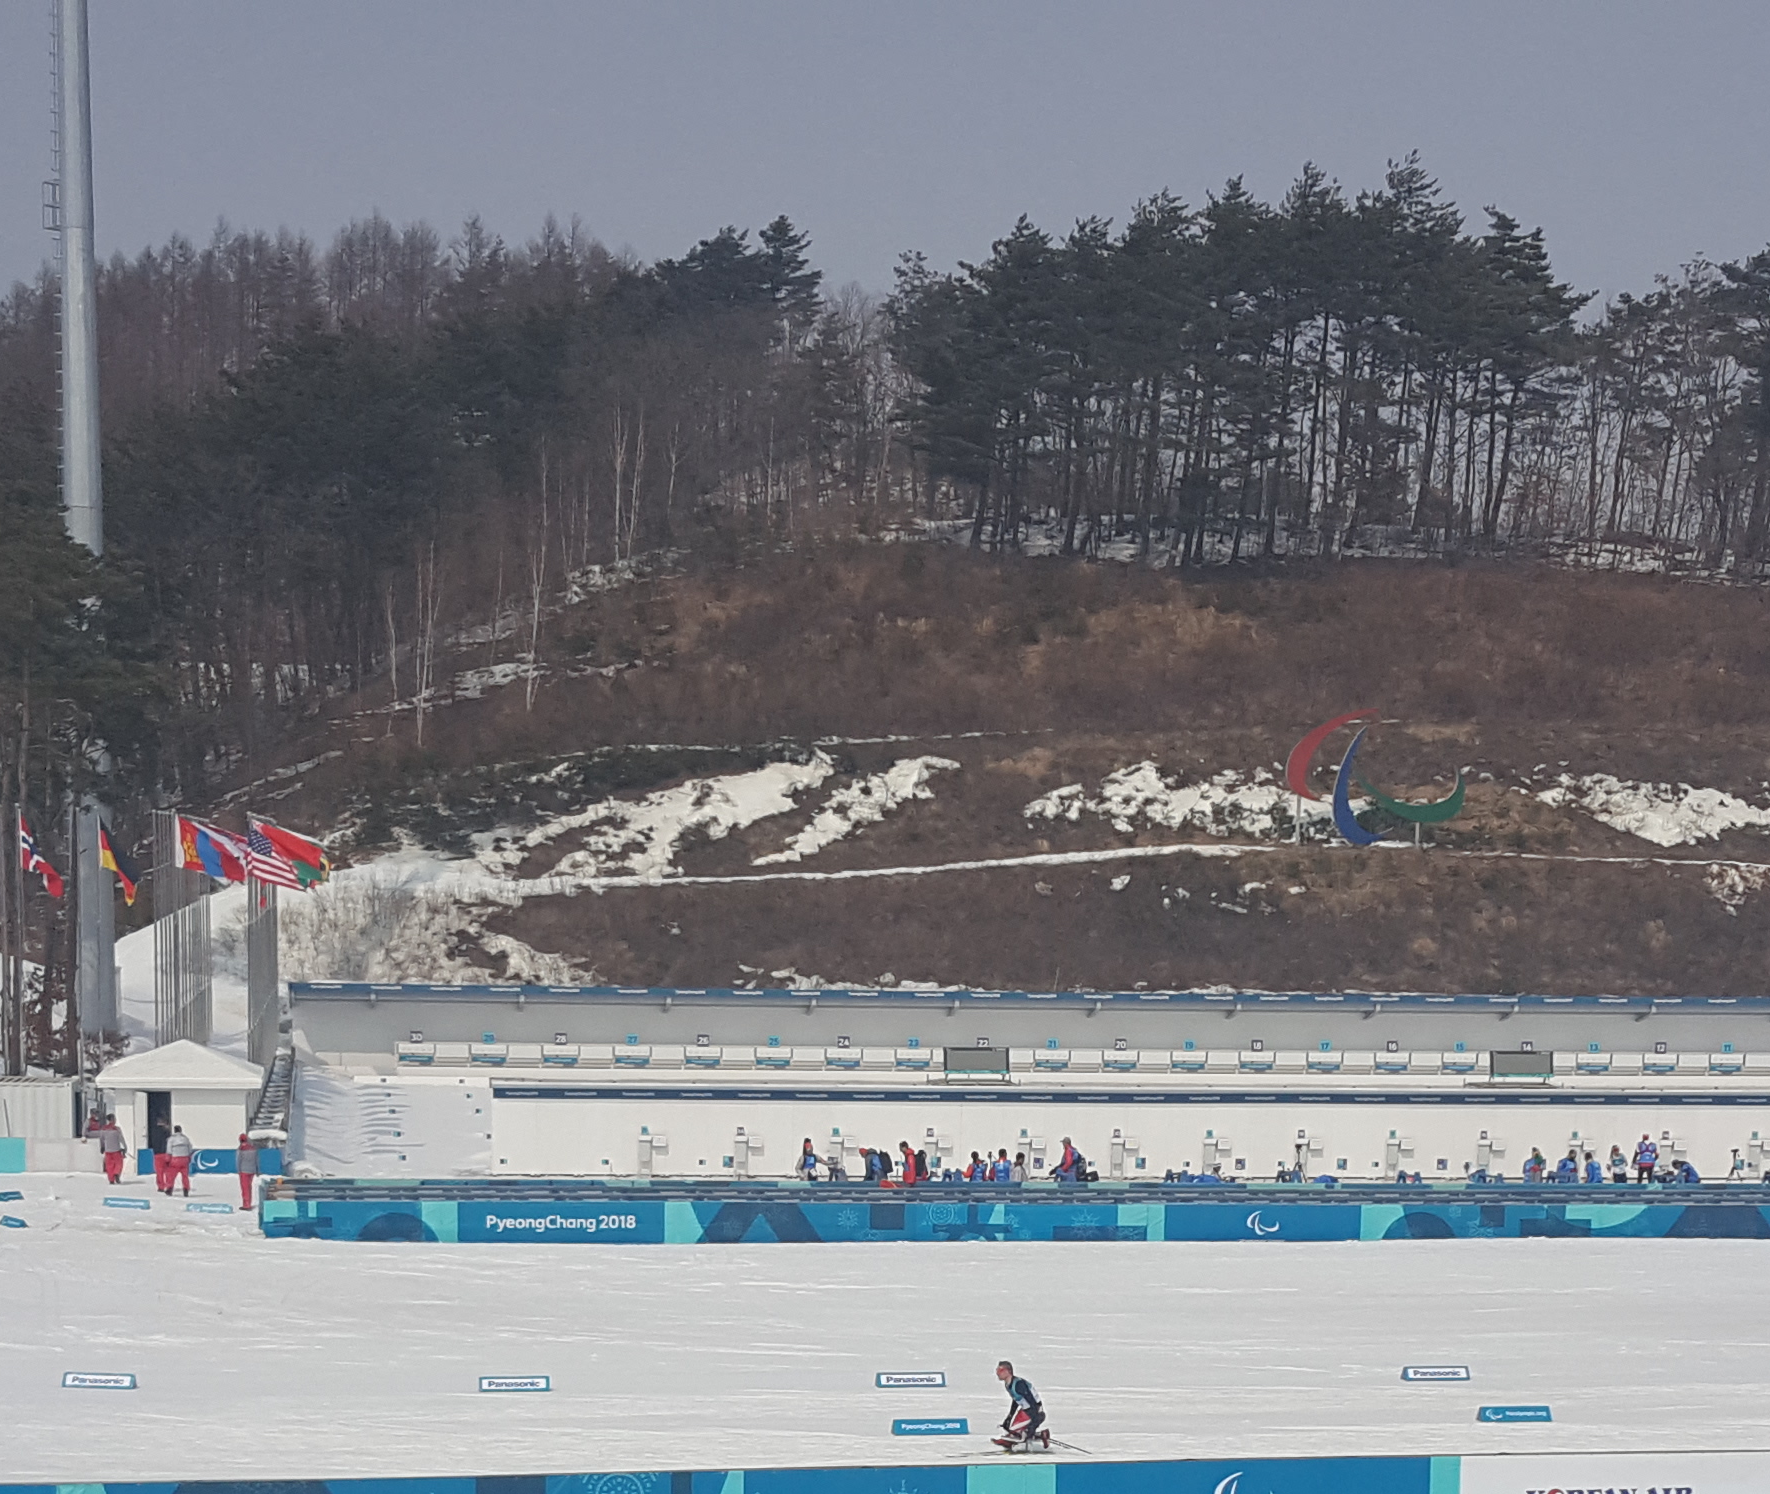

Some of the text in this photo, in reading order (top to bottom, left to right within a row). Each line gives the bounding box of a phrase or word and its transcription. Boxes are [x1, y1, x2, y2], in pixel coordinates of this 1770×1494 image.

[485, 1214, 637, 1232] PyeongChang 2018
[885, 1374, 937, 1385] Panasonic
[1412, 1369, 1461, 1379] Panasonic
[70, 1375, 125, 1386] Panasonic
[487, 1379, 540, 1389] Panasonic
